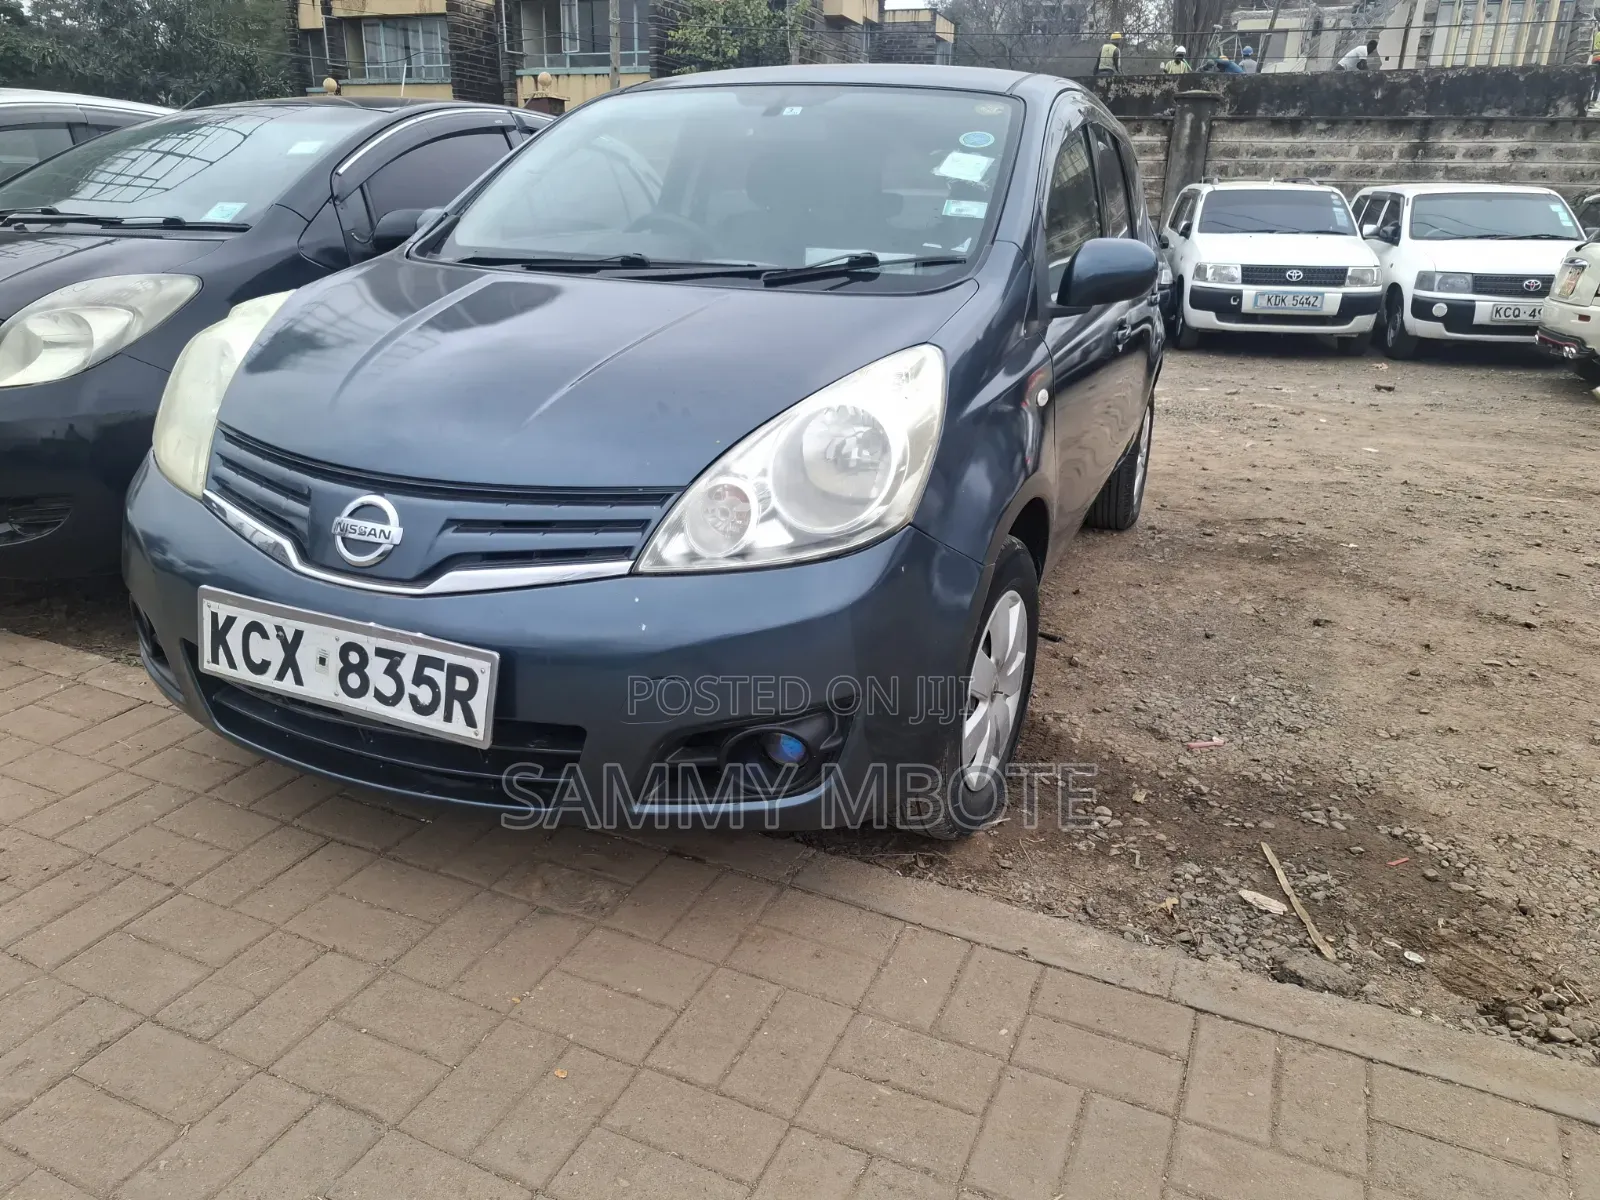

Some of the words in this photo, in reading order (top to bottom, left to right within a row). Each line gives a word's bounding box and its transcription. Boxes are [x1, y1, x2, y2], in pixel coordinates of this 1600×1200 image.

[1266, 294, 1288, 307] KDK
[1494, 306, 1521, 318] KCQ
[333, 521, 392, 541] NISSAN
[210, 610, 305, 687] KCX
[337, 641, 479, 729] 835R
